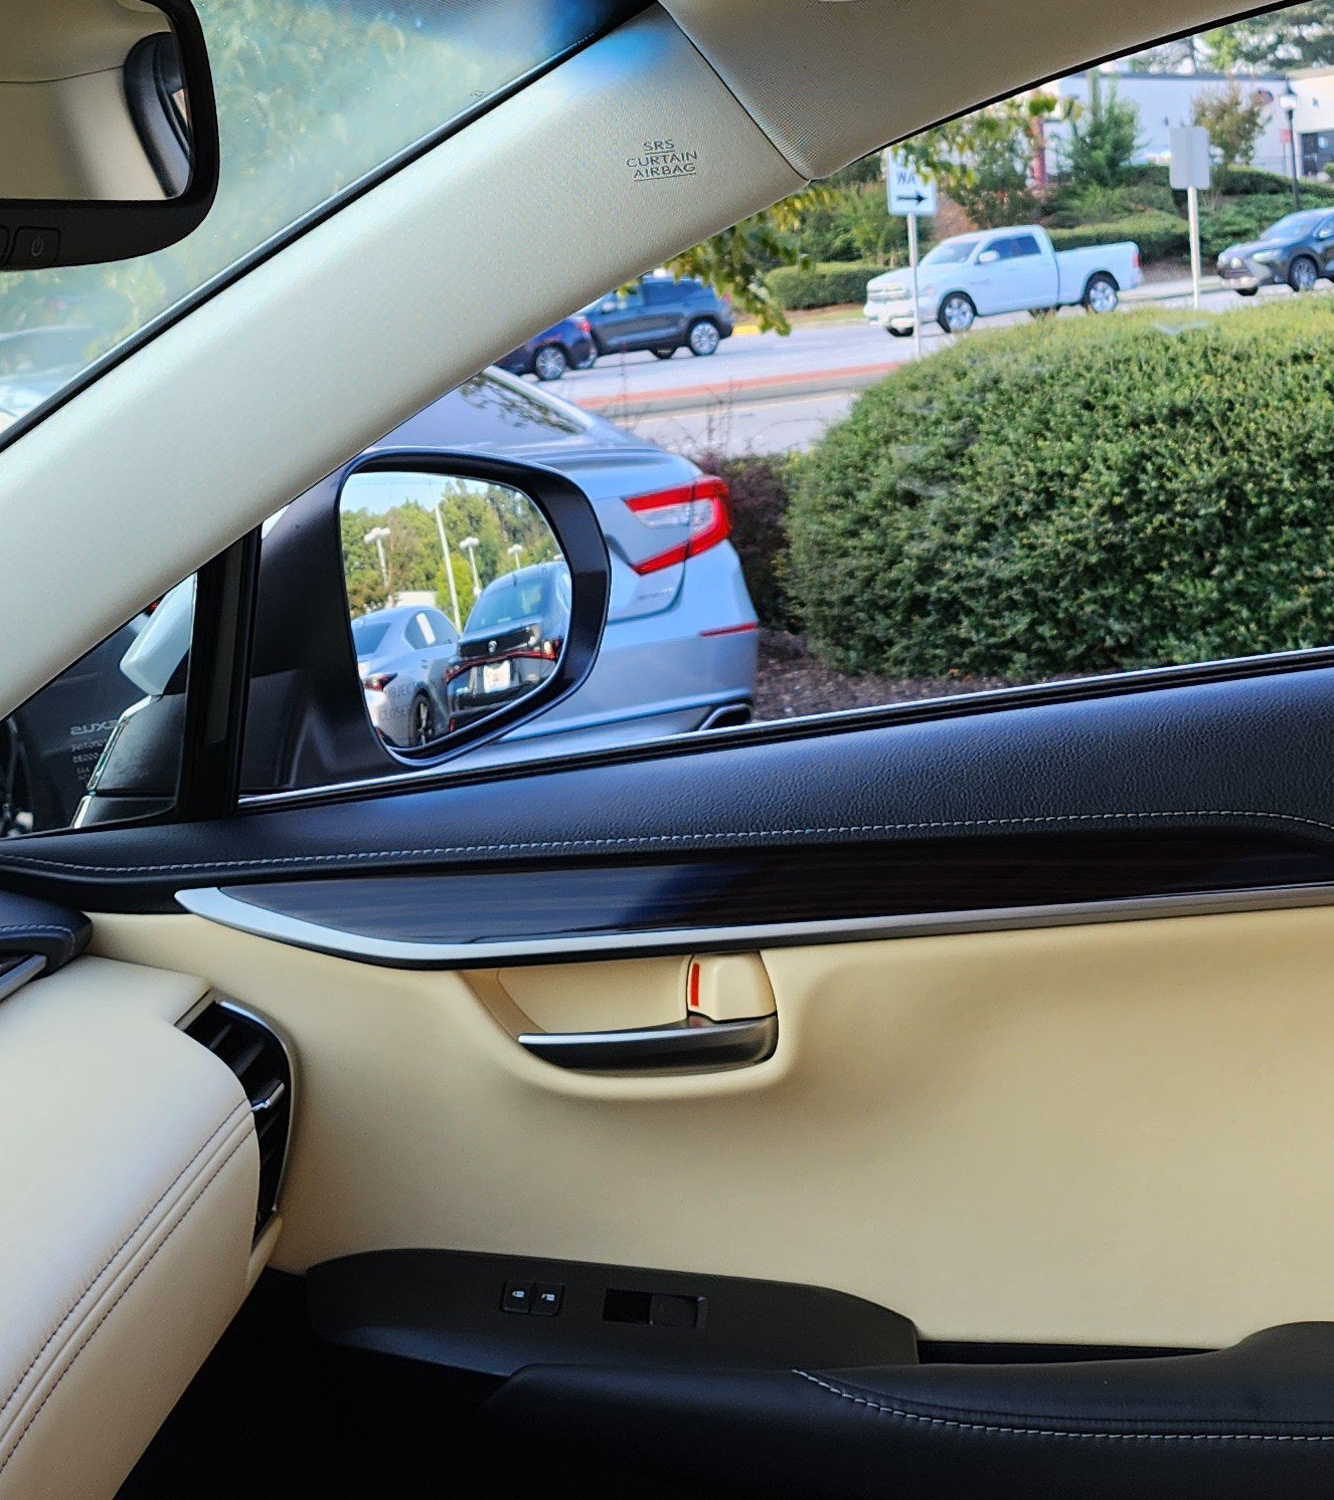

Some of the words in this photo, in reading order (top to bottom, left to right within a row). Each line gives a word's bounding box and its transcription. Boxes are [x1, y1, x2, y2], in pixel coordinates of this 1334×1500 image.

[643, 139, 675, 152] SRS
[626, 150, 698, 168] CURTAIN
[633, 162, 696, 179] AIRBAG
